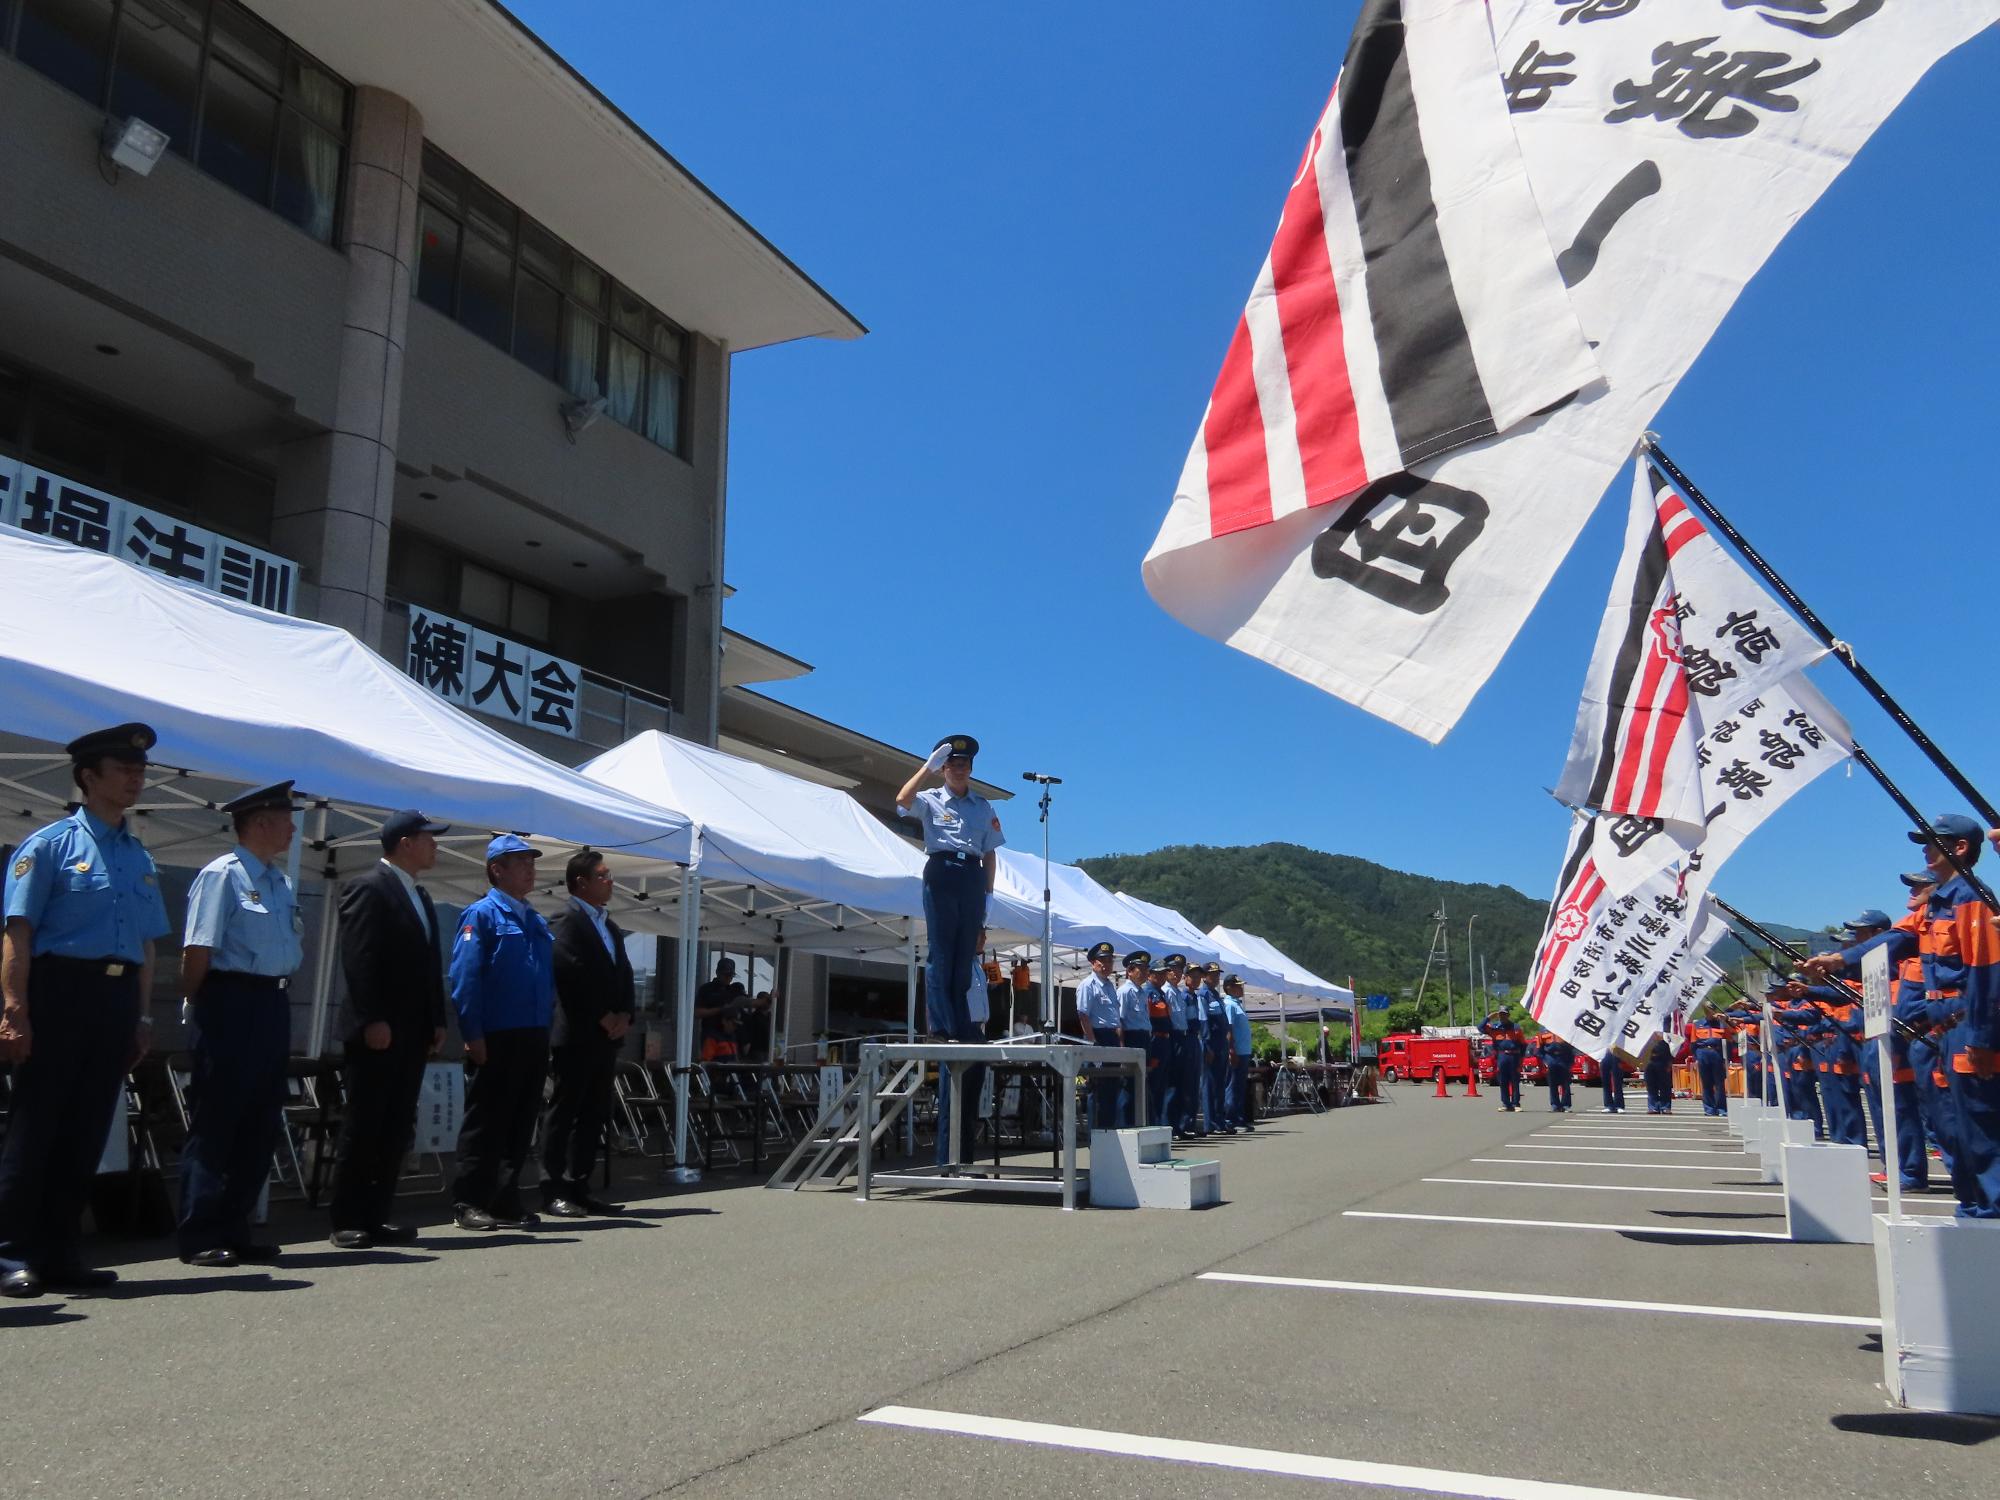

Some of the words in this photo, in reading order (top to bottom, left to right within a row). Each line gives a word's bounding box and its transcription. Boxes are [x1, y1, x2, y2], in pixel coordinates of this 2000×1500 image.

[0, 475, 290, 614] 操法訓
[410, 613, 577, 733] 練大会
